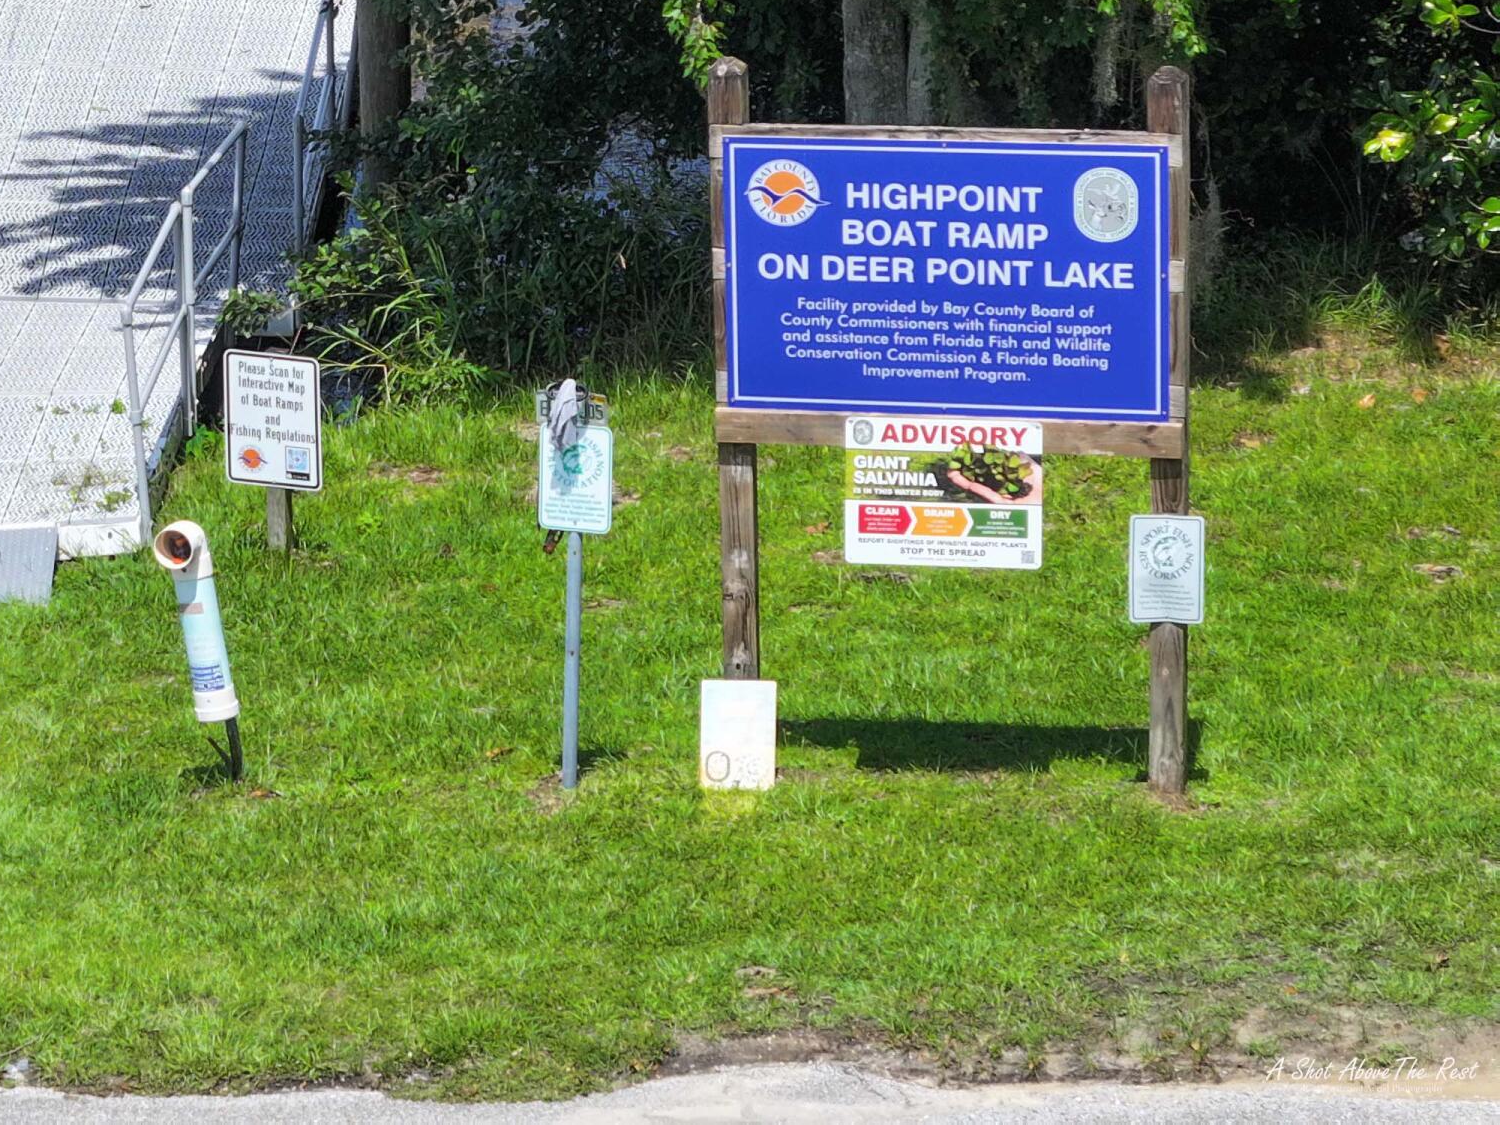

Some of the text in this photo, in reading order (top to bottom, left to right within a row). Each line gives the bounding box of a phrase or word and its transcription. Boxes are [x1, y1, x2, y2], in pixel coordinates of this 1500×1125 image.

[754, 162, 817, 192] BAY COUNTY
[846, 182, 1044, 213] HIGHPOINT
[753, 197, 814, 224] FLORIDA
[841, 218, 1049, 250] BOAT RAMP
[757, 252, 1135, 290] ON DEER POINT LAKE
[797, 297, 1095, 319] Facility provided by Bay County Board of
[780, 312, 1112, 337] County Commissioners with financial support
[782, 329, 1111, 352] and assistance from Florida Fish and Wildlife
[785, 344, 1109, 371] Conservation Commission & Florida Boating
[238, 361, 304, 379] Please Scan for
[862, 363, 1031, 383] Improvement Program.
[238, 376, 305, 395] Interactive Map
[241, 394, 304, 412] of Boat Ramps
[265, 414, 281, 425] and
[230, 423, 316, 443] Fishing Regulations
[880, 424, 1027, 447] ADVISORY
[853, 455, 910, 470] GIANT
[853, 470, 938, 487] SALVINIA
[864, 506, 900, 516] CLEAN
[923, 509, 955, 517] DRAIN
[989, 510, 1012, 519] DRY
[900, 547, 924, 555] STOP
[948, 549, 986, 557] SPREAD
